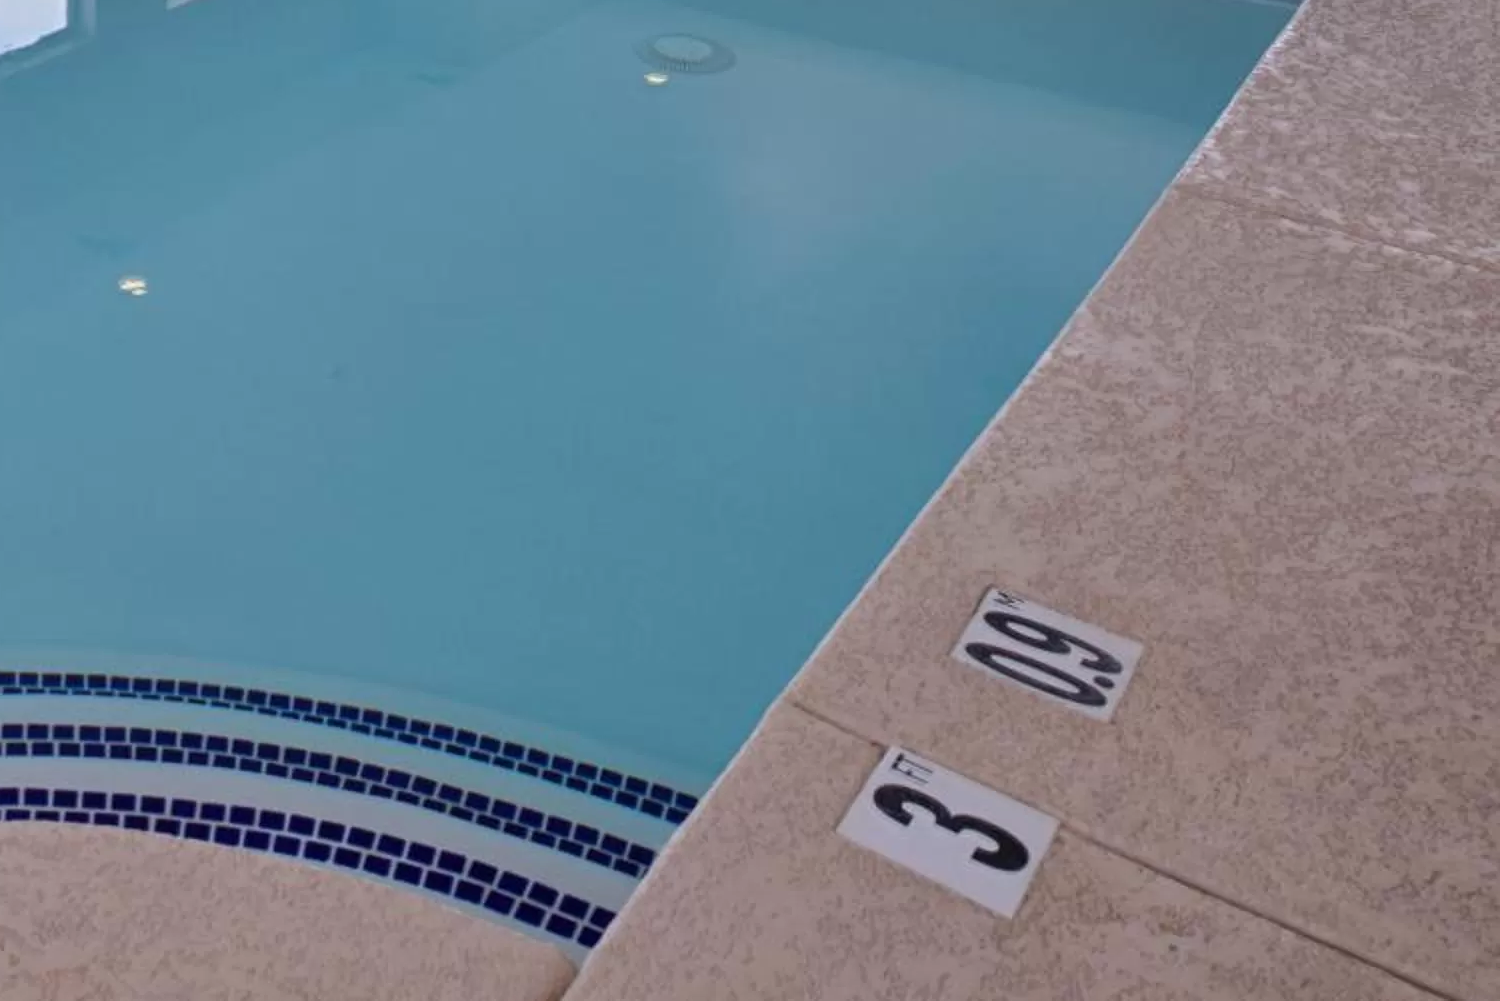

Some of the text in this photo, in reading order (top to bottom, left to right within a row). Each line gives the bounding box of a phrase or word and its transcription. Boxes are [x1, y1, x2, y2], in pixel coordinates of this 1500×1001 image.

[964, 611, 1123, 707] 0.9
[873, 753, 1030, 872] 3 FT
